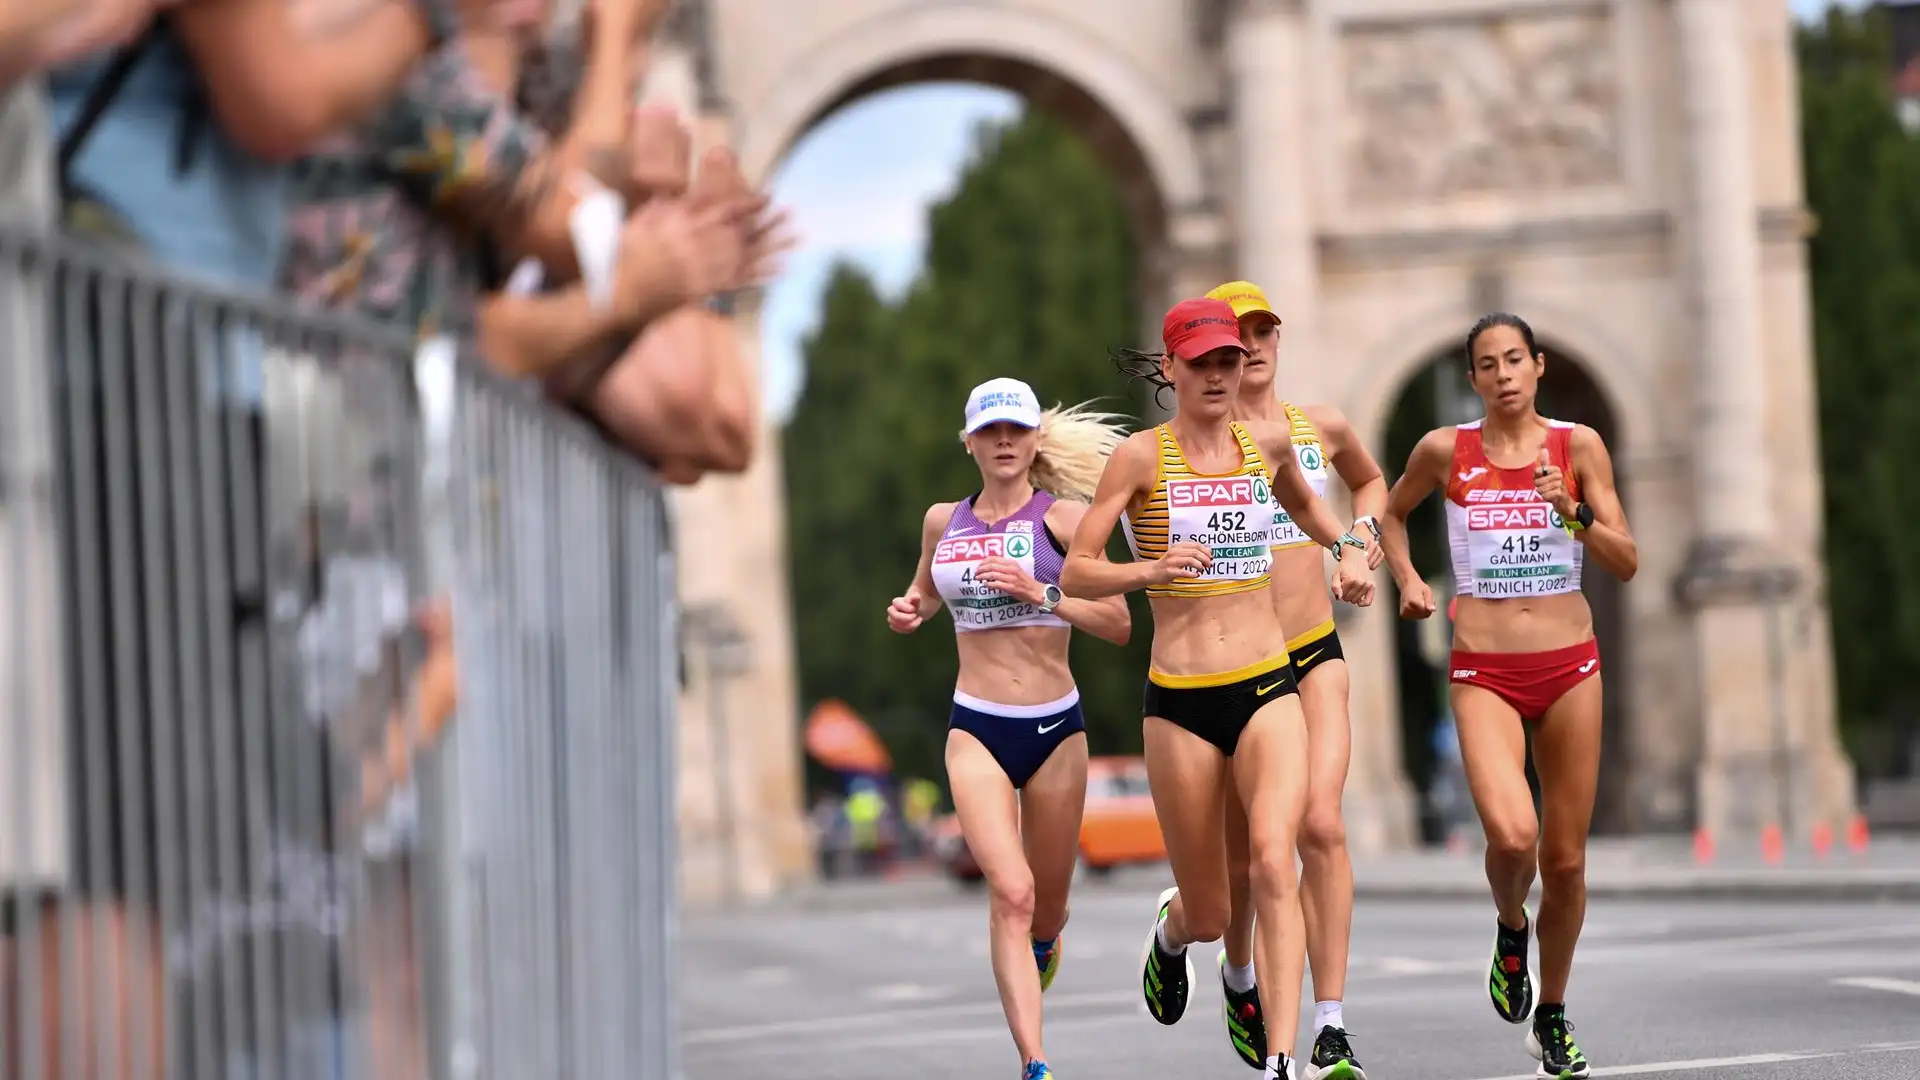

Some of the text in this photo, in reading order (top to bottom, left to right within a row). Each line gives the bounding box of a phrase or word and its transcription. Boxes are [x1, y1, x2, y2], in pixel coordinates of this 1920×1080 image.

[980, 392, 1020, 403] GREAT
[980, 399, 1022, 411] BRITAIN
[1172, 483, 1251, 504] SPAR
[1207, 511, 1246, 531] 452
[1469, 508, 1545, 528] SPAR
[1189, 530, 1268, 544] SCHÖNEBORN
[1502, 535, 1540, 553] 415
[937, 538, 1003, 562] SPAR
[1226, 548, 1253, 557] CLEAN
[1490, 552, 1552, 565] GALIMANY
[1243, 559, 1268, 575] 2022
[1498, 568, 1519, 577] RUN
[1521, 567, 1550, 576] CLEAN
[1478, 577, 1567, 594] MUNICH 2022
[980, 599, 1009, 608] CLEAN
[998, 604, 1033, 620] 2022
[1453, 669, 1477, 678] ESP
